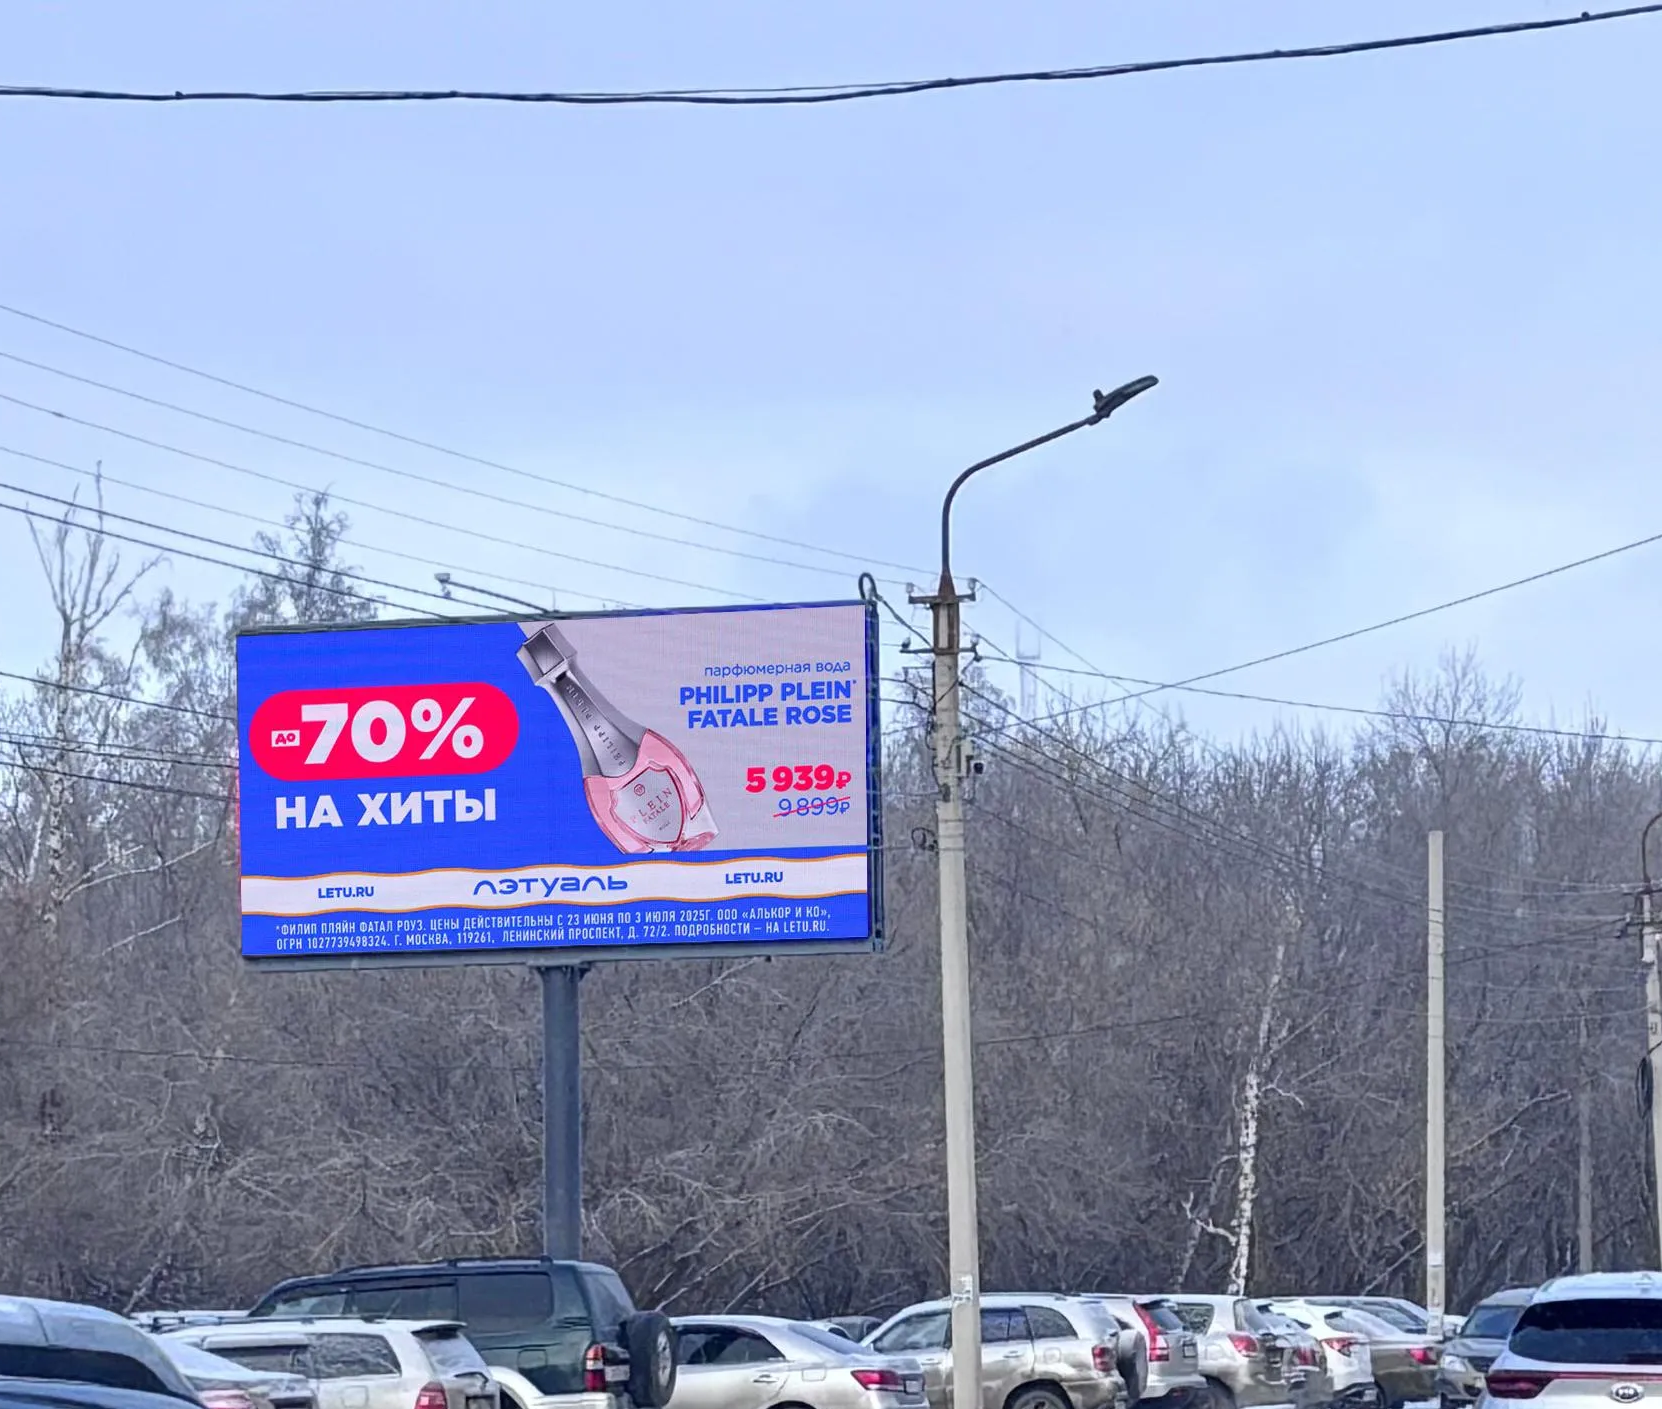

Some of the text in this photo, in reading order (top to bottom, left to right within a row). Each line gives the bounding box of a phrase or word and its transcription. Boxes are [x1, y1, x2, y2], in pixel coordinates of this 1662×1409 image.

[704, 661, 851, 678] парфюмерная вода
[679, 683, 774, 706] PHILIPP
[687, 704, 853, 729] FATALE ROSE
[274, 787, 497, 830] НА ХИТЫ
[724, 870, 784, 885] LETU.RU
[317, 886, 375, 899] LETU.RU
[321, 919, 356, 935] ПЛЯЙН
[359, 920, 393, 933] ФАТАЛ
[396, 919, 426, 932] РОУЗ.
[430, 918, 460, 931] ЦЕНЫ
[463, 913, 553, 930] ДЕЙСТВИТЕЛЬНЫ
[557, 914, 563, 926] С
[567, 913, 580, 926] 23
[583, 912, 614, 925] ИЮНЯ
[617, 911, 631, 924] ПО
[635, 911, 641, 923] 3
[645, 910, 676, 923] ИЮЛЯ
[717, 908, 738, 921] ООО
[795, 906, 802, 918] И
[276, 937, 303, 950] ОГРН
[406, 932, 452, 946] МОСКВА,
[502, 927, 565, 943] ЛЕНИНСКИЙ
[568, 926, 624, 940] ПРОСПЕКТ,
[674, 922, 751, 938] ПОДРОБНОСТИ
[765, 922, 780, 933] НА
[783, 919, 830, 932] LETU.RU.
